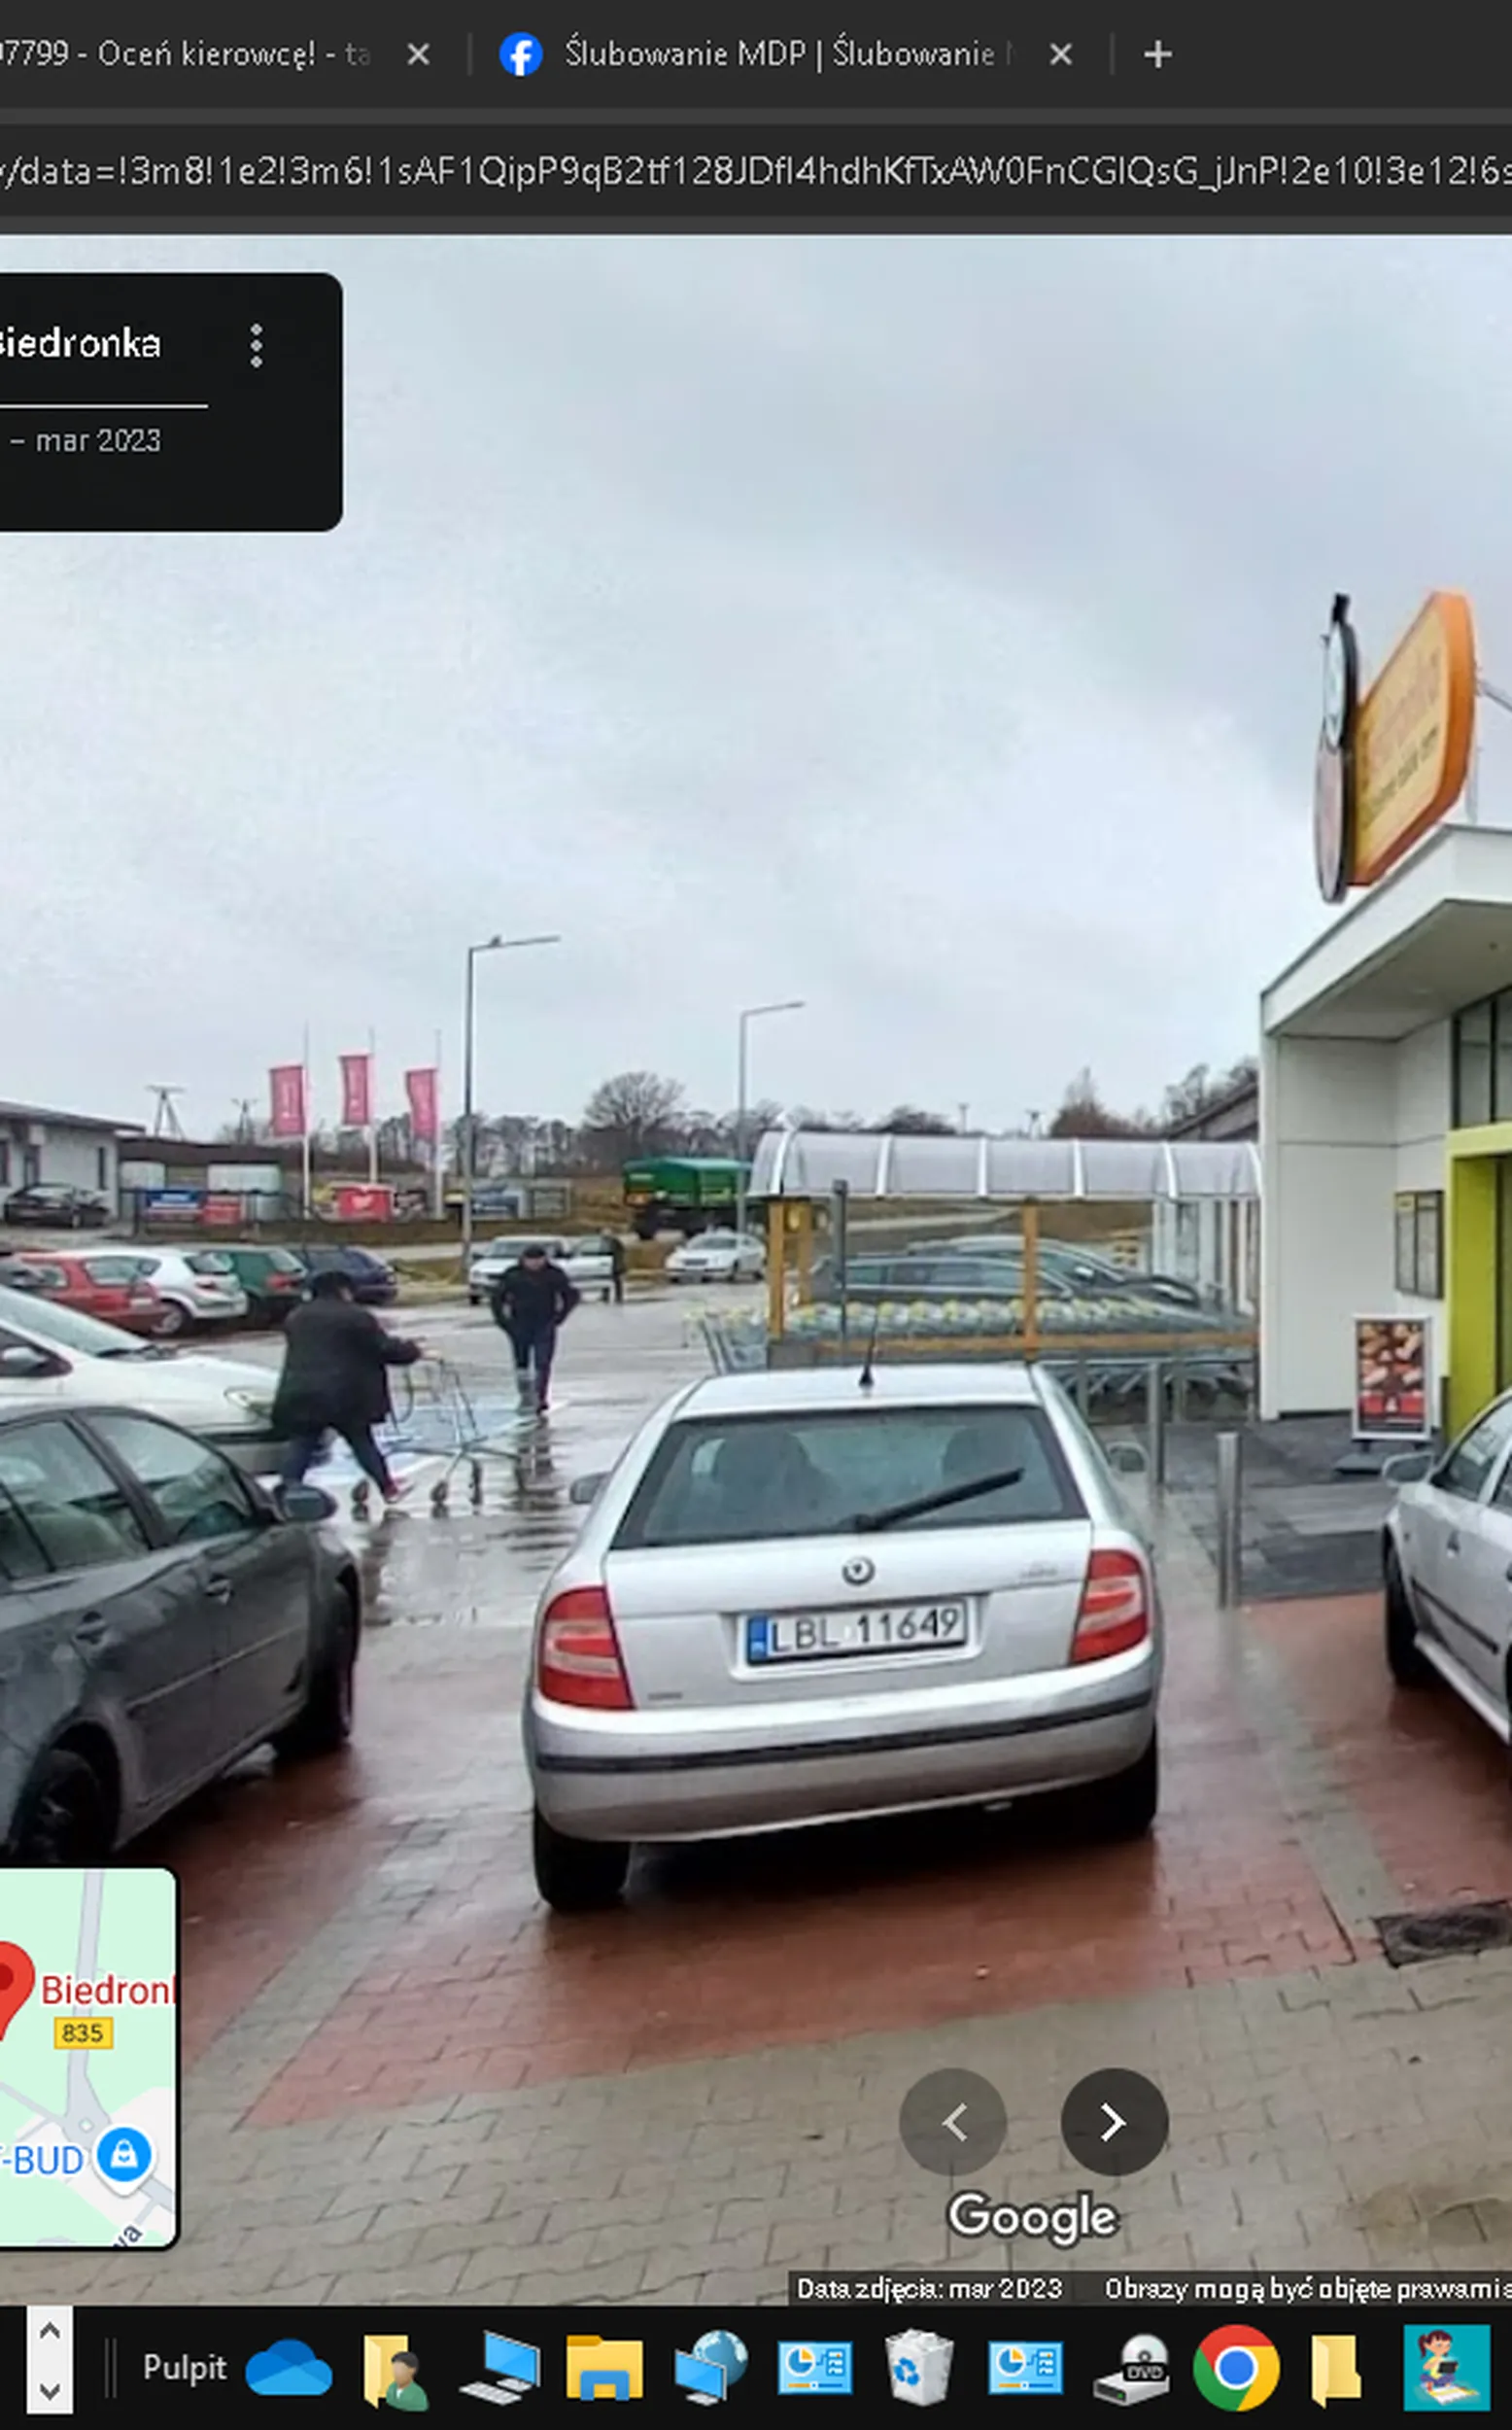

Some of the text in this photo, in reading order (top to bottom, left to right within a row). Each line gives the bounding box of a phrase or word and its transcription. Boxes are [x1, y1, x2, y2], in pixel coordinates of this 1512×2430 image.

[0, 40, 69, 66] 7799
[99, 40, 171, 66] Oceń
[183, 40, 315, 72] kierowcę!
[567, 32, 728, 67] Ślubowanie
[739, 40, 807, 66] MDP
[834, 32, 995, 67] Ślubowanie
[773, 1608, 958, 1651] LBL 11649
[145, 2354, 228, 2388] Pulpit
